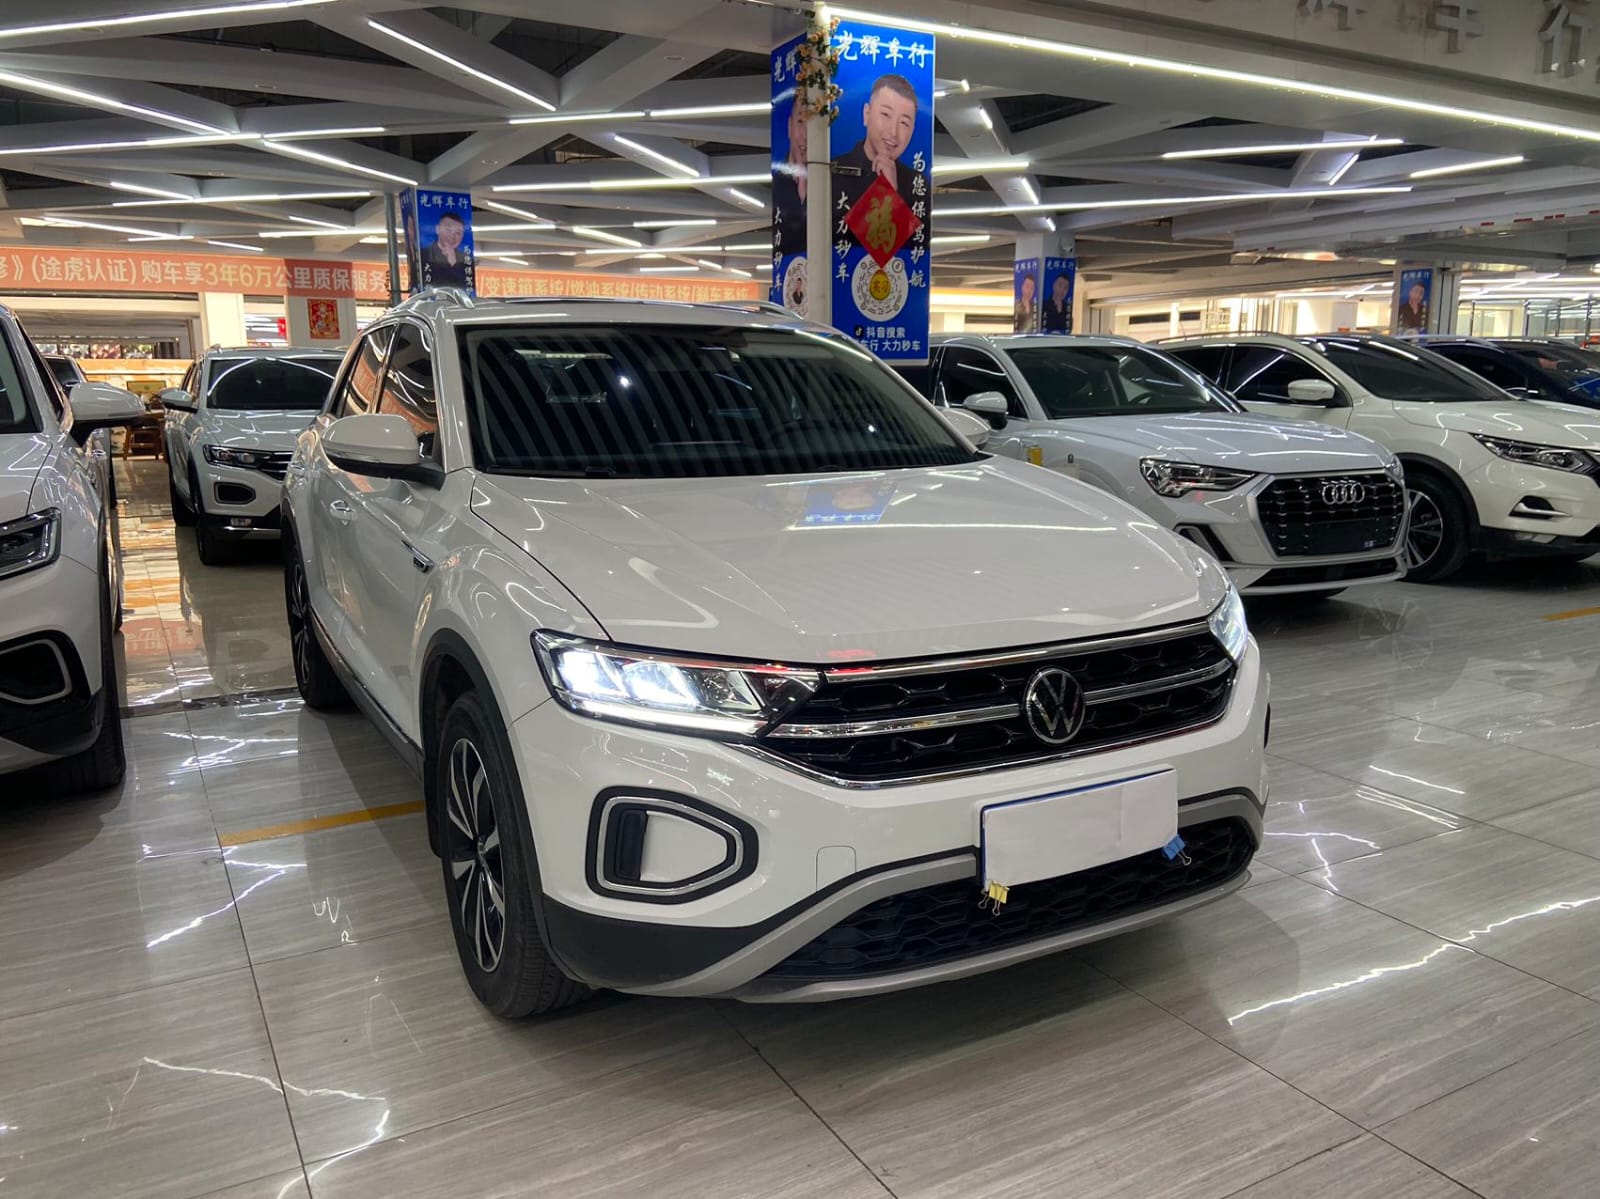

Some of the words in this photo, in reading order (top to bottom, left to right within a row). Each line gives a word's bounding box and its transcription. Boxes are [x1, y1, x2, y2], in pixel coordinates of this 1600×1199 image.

[835, 30, 926, 69] 光辉车行
[834, 191, 851, 284] 大力秒车
[865, 195, 897, 254] 福
